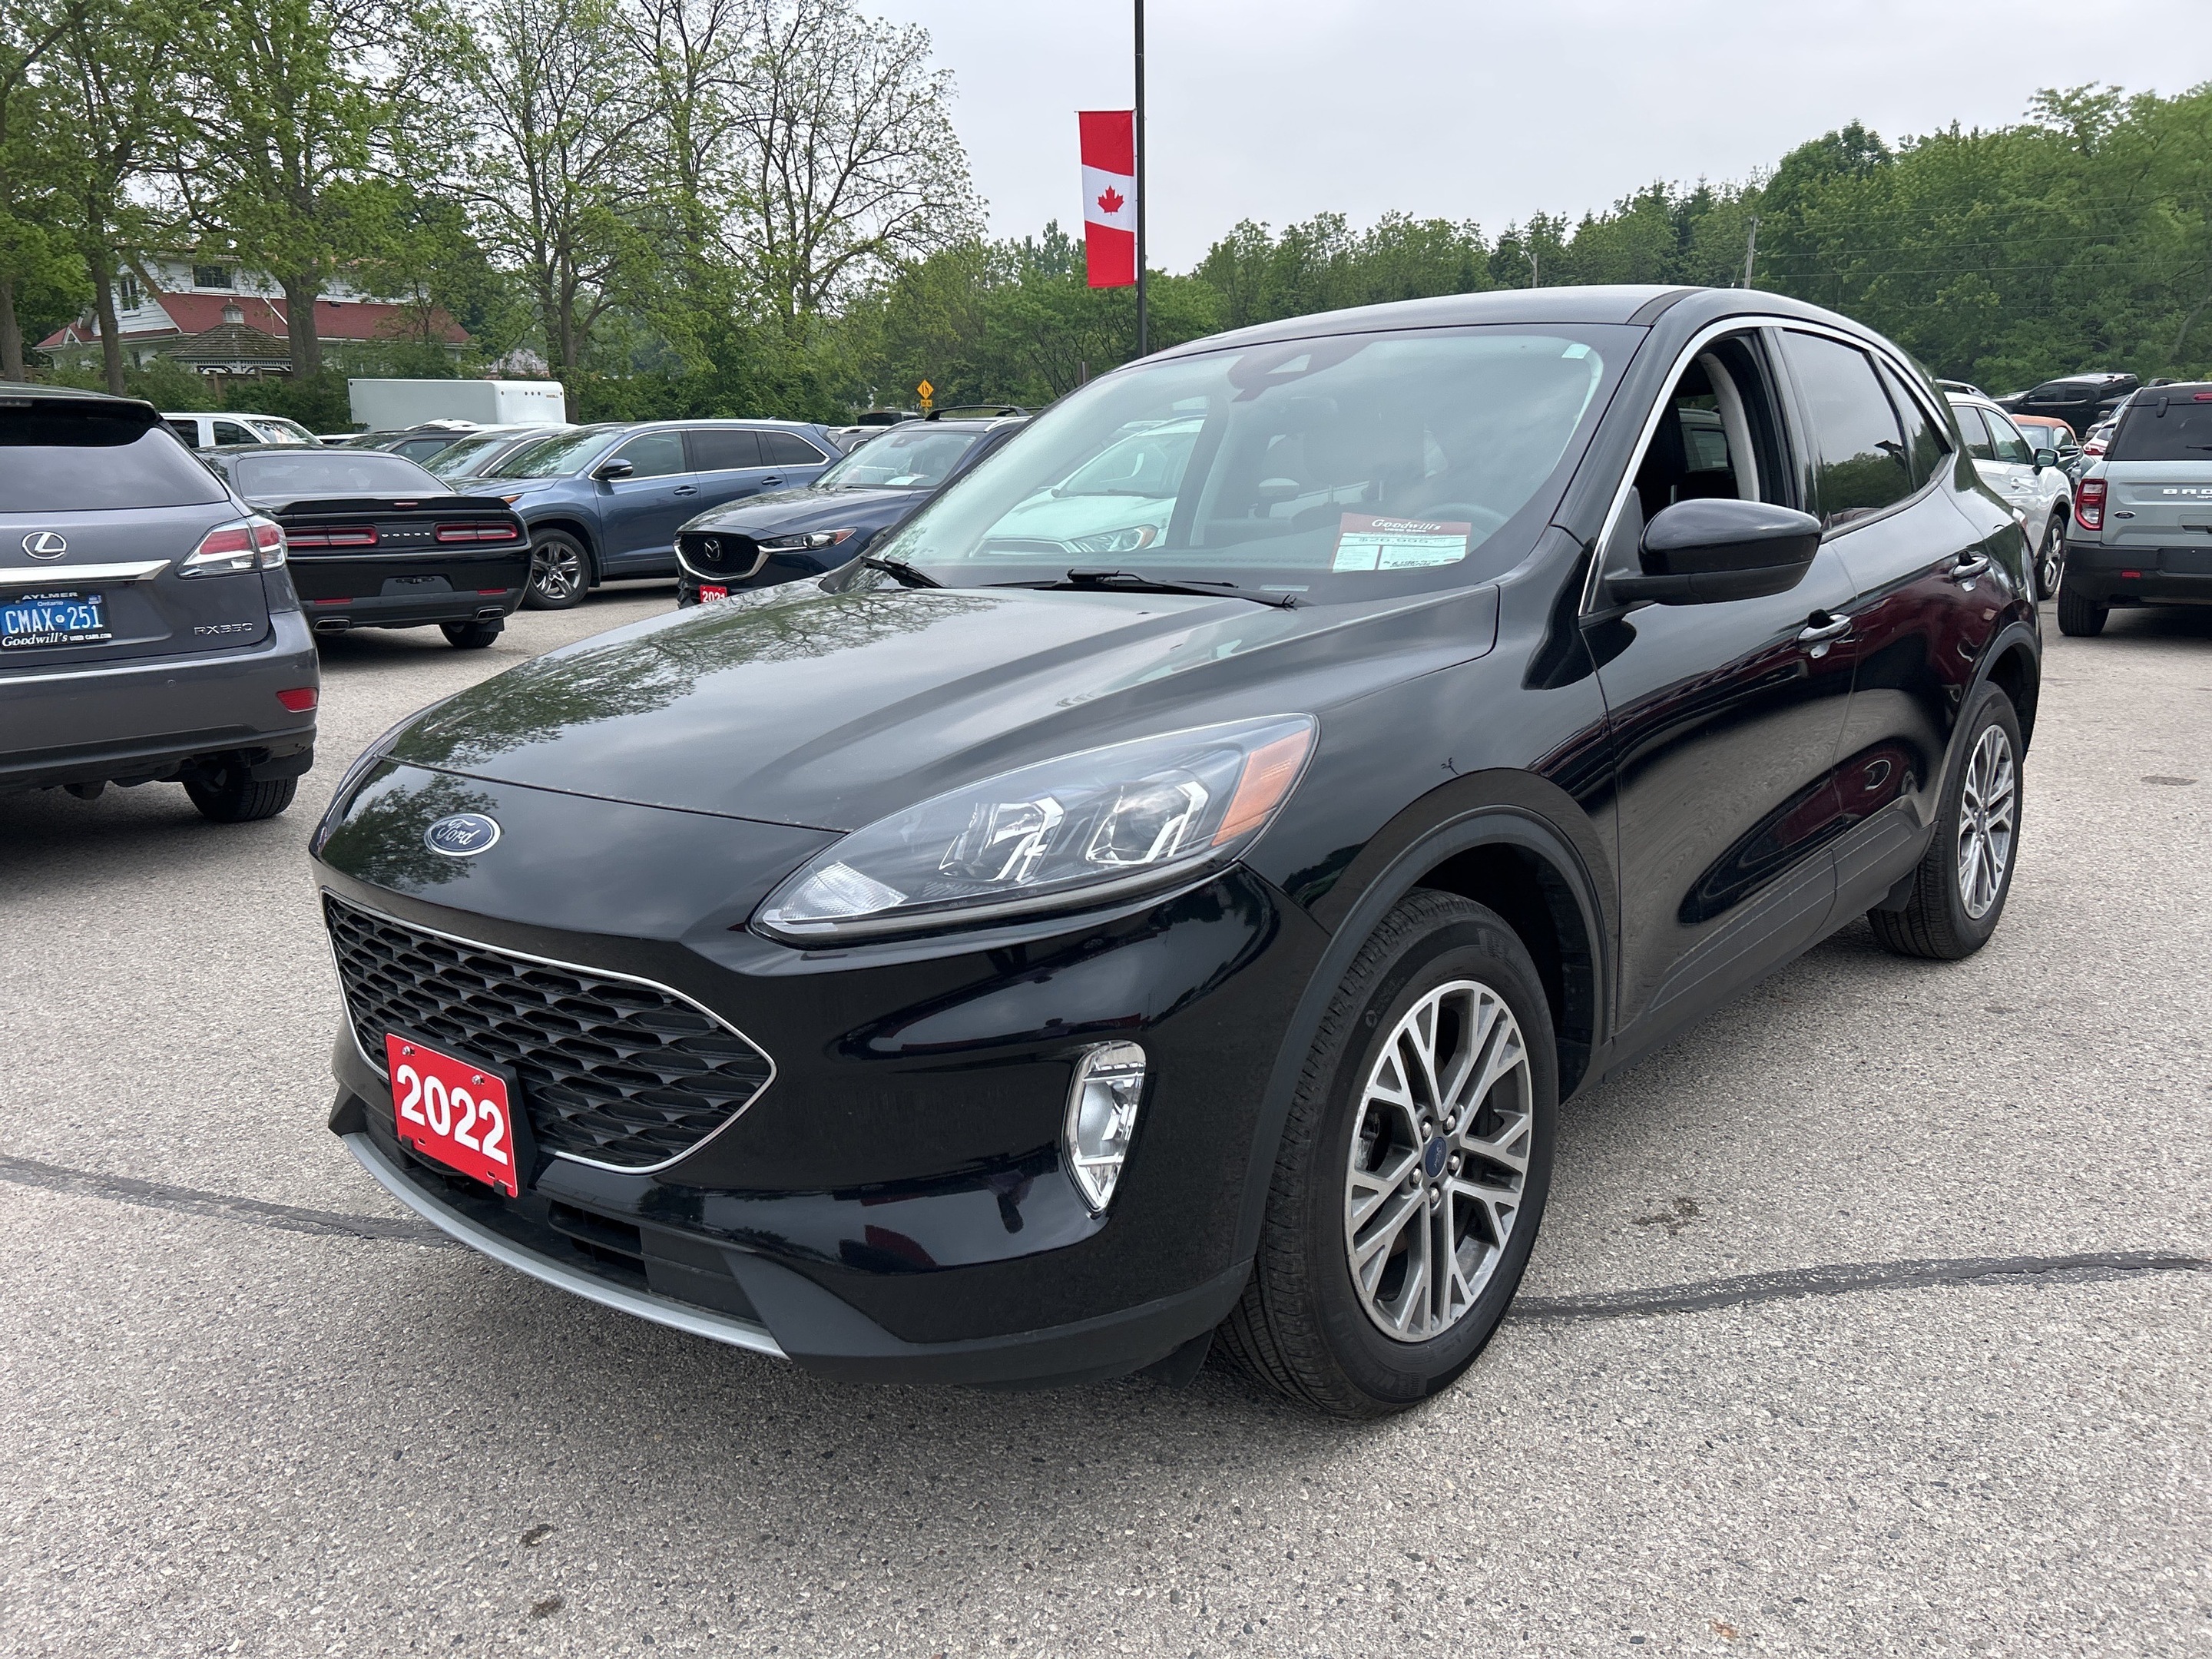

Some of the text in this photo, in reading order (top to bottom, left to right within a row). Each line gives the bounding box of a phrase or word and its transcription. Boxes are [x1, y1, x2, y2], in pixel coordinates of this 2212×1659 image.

[1372, 519, 1442, 530] Goodwill's
[5, 604, 104, 634] CMAX 251
[2, 632, 68, 647] Goodwill's
[436, 819, 482, 846] Ford
[396, 1064, 508, 1166] 2022
